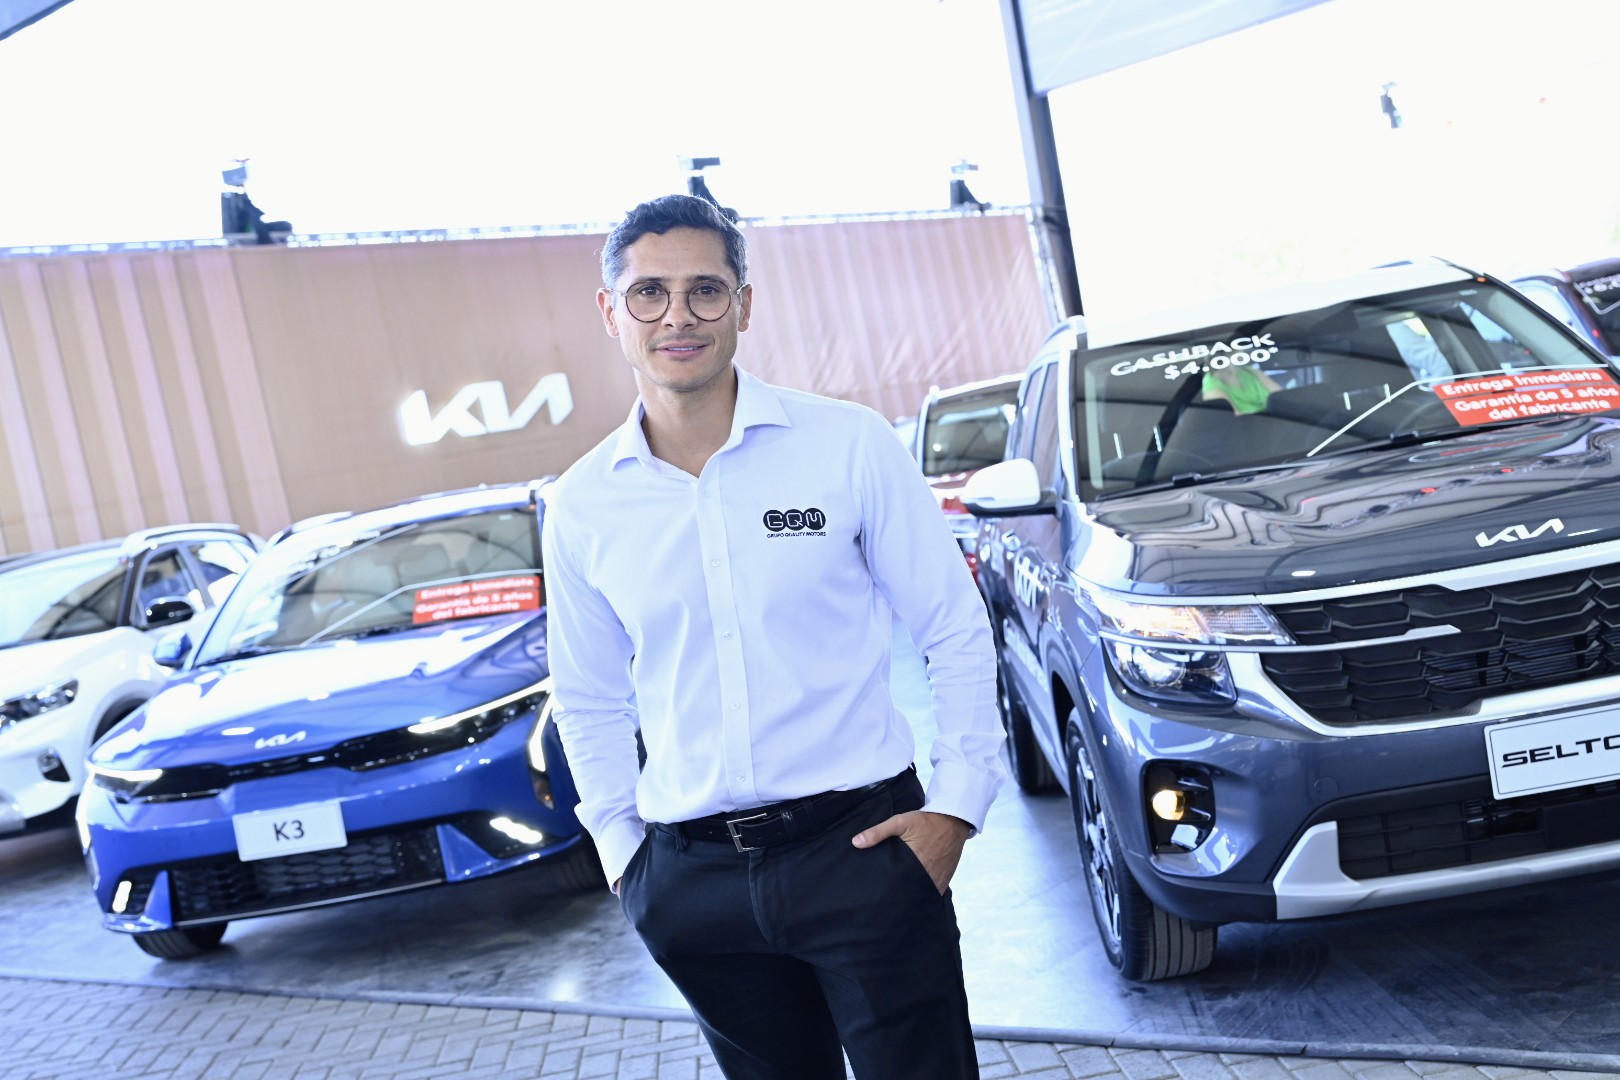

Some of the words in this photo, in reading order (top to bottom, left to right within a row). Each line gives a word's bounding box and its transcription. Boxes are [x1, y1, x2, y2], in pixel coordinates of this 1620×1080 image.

[1110, 333, 1276, 376] CASHBACK
[1441, 378, 1513, 396] Entrega
[1535, 390, 1559, 401] de
[1560, 388, 1574, 399] 5
[1576, 386, 1619, 398] años
[399, 372, 574, 446] KIA
[1488, 406, 1518, 420] del
[1519, 398, 1611, 416] fabricante
[765, 509, 825, 530] GQM
[1475, 518, 1564, 548] KIA
[273, 820, 304, 842] K3
